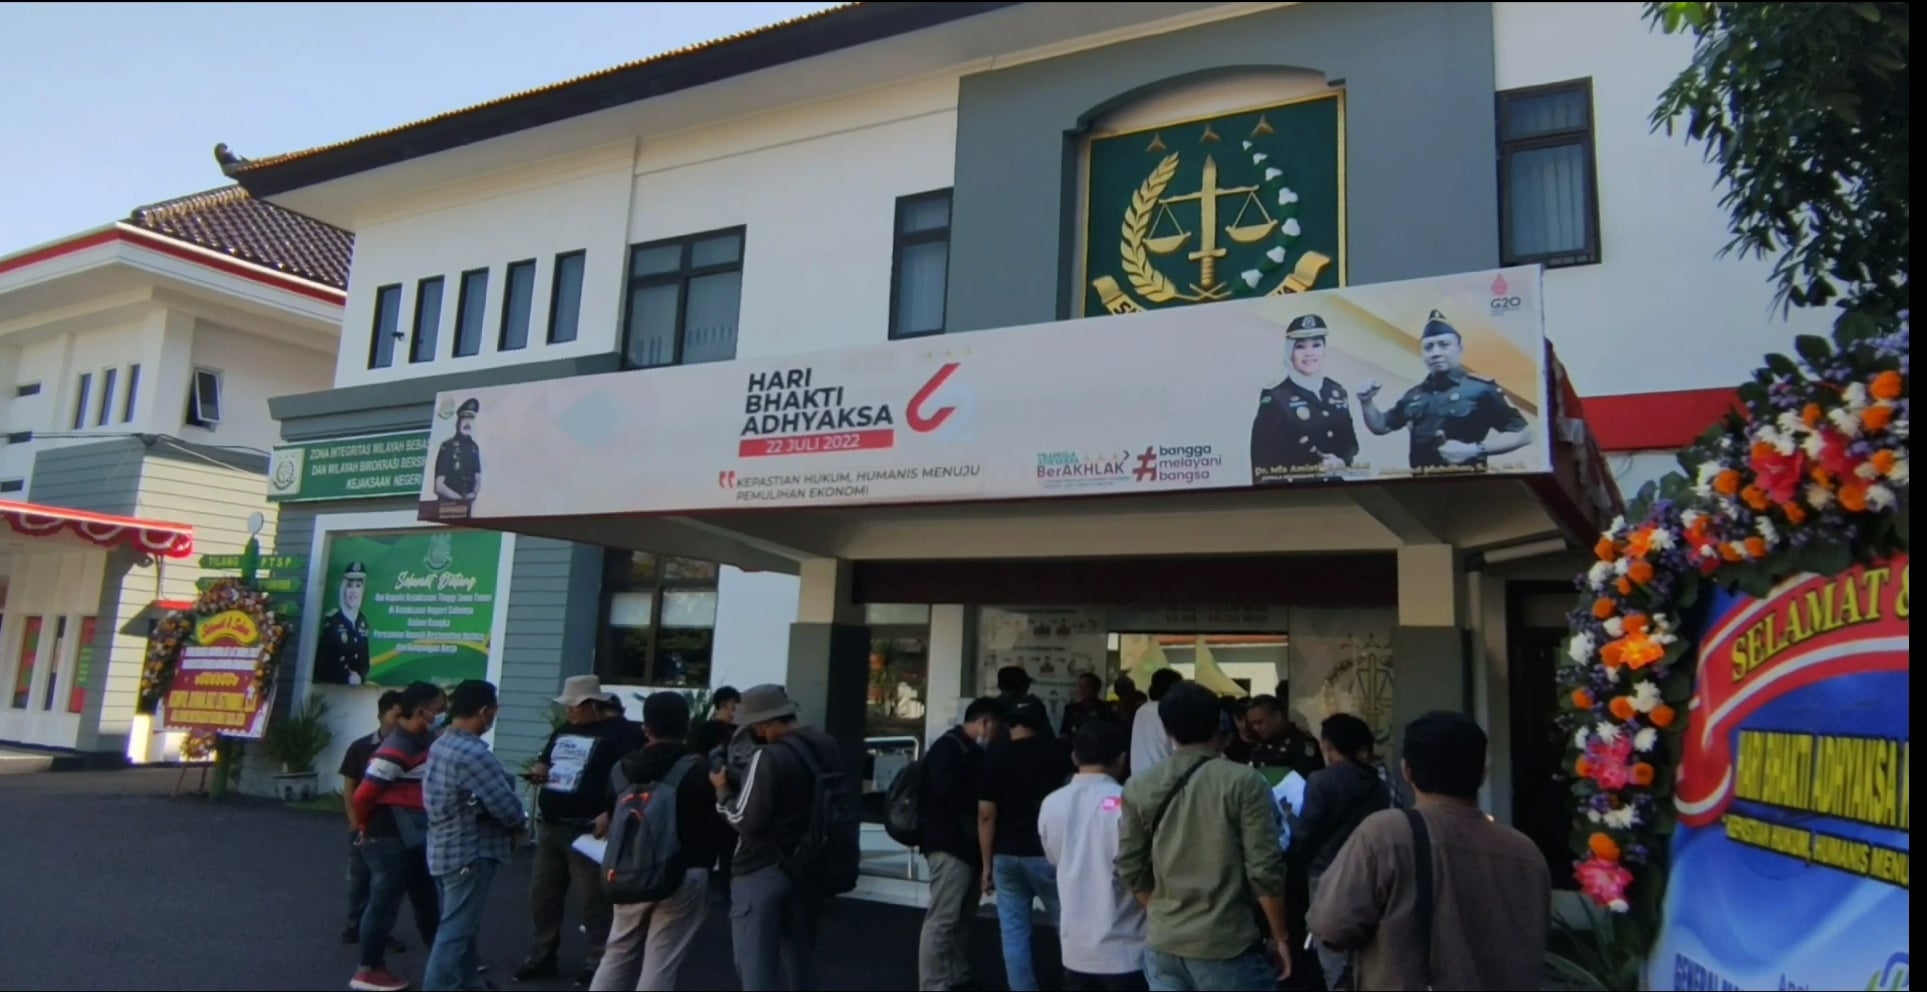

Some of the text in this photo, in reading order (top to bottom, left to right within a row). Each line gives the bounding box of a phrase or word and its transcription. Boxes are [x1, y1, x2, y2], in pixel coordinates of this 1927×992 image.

[1490, 296, 1521, 309] G20
[748, 368, 812, 392] HARI
[745, 386, 843, 414] BHAKTI
[741, 404, 894, 436] ADHYAKSA
[331, 443, 371, 458] INTEGRITAS
[372, 440, 405, 454] WILAYAH
[766, 433, 860, 453] 22 JULI 2022
[1159, 445, 1212, 457] bangga
[311, 464, 327, 476] DAN
[328, 460, 359, 474] WILAYAH
[1037, 461, 1125, 478] BerAKHLAK
[1159, 454, 1222, 469] melayani
[345, 476, 392, 490] KEJAKSAAN
[737, 464, 980, 488] KEPASTIAN HUKUM, HUMANIS MENUJU
[1159, 469, 1211, 483] bangsa
[737, 485, 869, 501] PEMULIHAN EKONOMI
[1732, 567, 1890, 682] SELAMAT
[1812, 735, 1898, 827] ADHYAKSA
